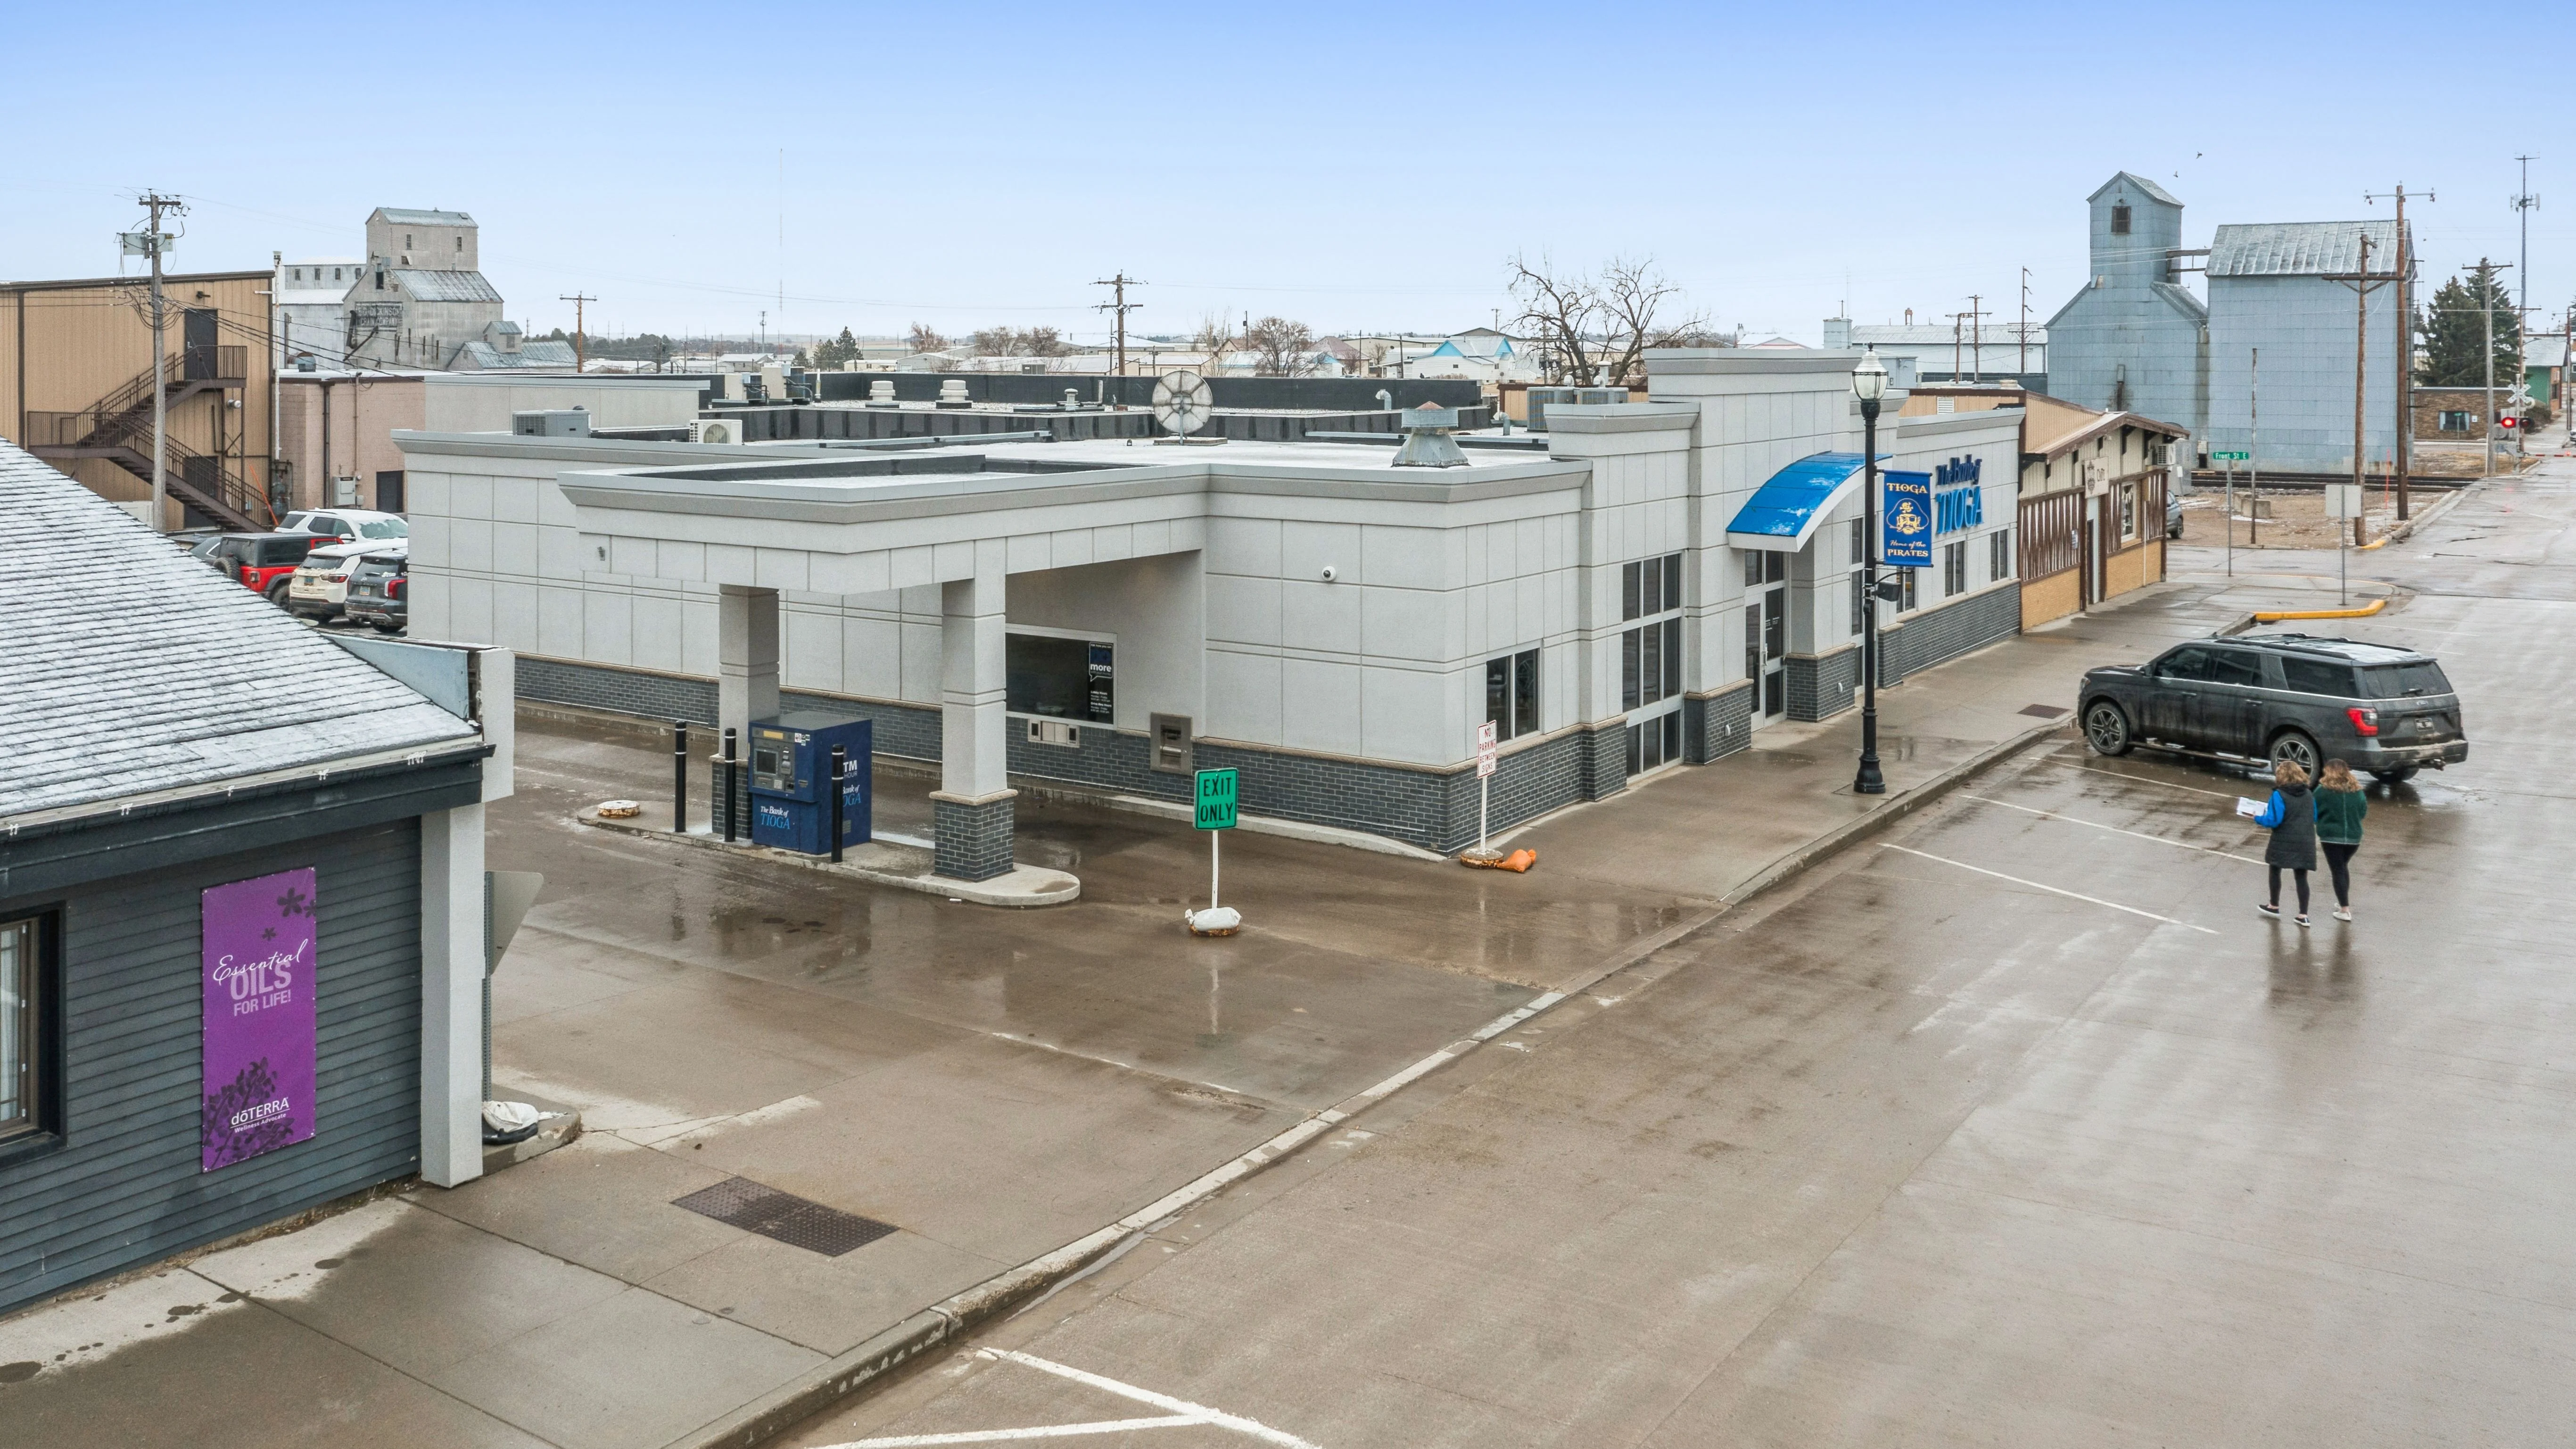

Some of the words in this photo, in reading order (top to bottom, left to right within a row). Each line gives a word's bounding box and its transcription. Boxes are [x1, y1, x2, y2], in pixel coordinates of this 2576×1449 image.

[1935, 464, 1952, 486] The
[1950, 454, 1974, 483] Bank
[1886, 483, 1928, 494] TIOGA
[1935, 486, 1984, 534] TIOGA
[1908, 541, 1916, 550] of
[1887, 549, 1929, 557] PIRATES
[1090, 664, 1112, 673] more
[1485, 727, 1491, 738] NO
[1479, 739, 1495, 753] PARKING
[1480, 752, 1495, 764] BETWEEN
[843, 760, 858, 773] TM
[1482, 763, 1493, 773] SIGNS
[854, 784, 860, 793] of
[1204, 777, 1231, 797] EXIT
[769, 806, 783, 815] Bank
[783, 810, 789, 818] of
[1200, 802, 1233, 822] ONLY
[761, 813, 790, 830] TIOGA
[213, 939, 308, 986] Essential
[231, 962, 291, 1000] OILS
[234, 998, 259, 1017] FOR
[263, 989, 291, 1009] LIFE!
[234, 1121, 260, 1133] Wellness
[261, 1113, 287, 1125] Advocate
